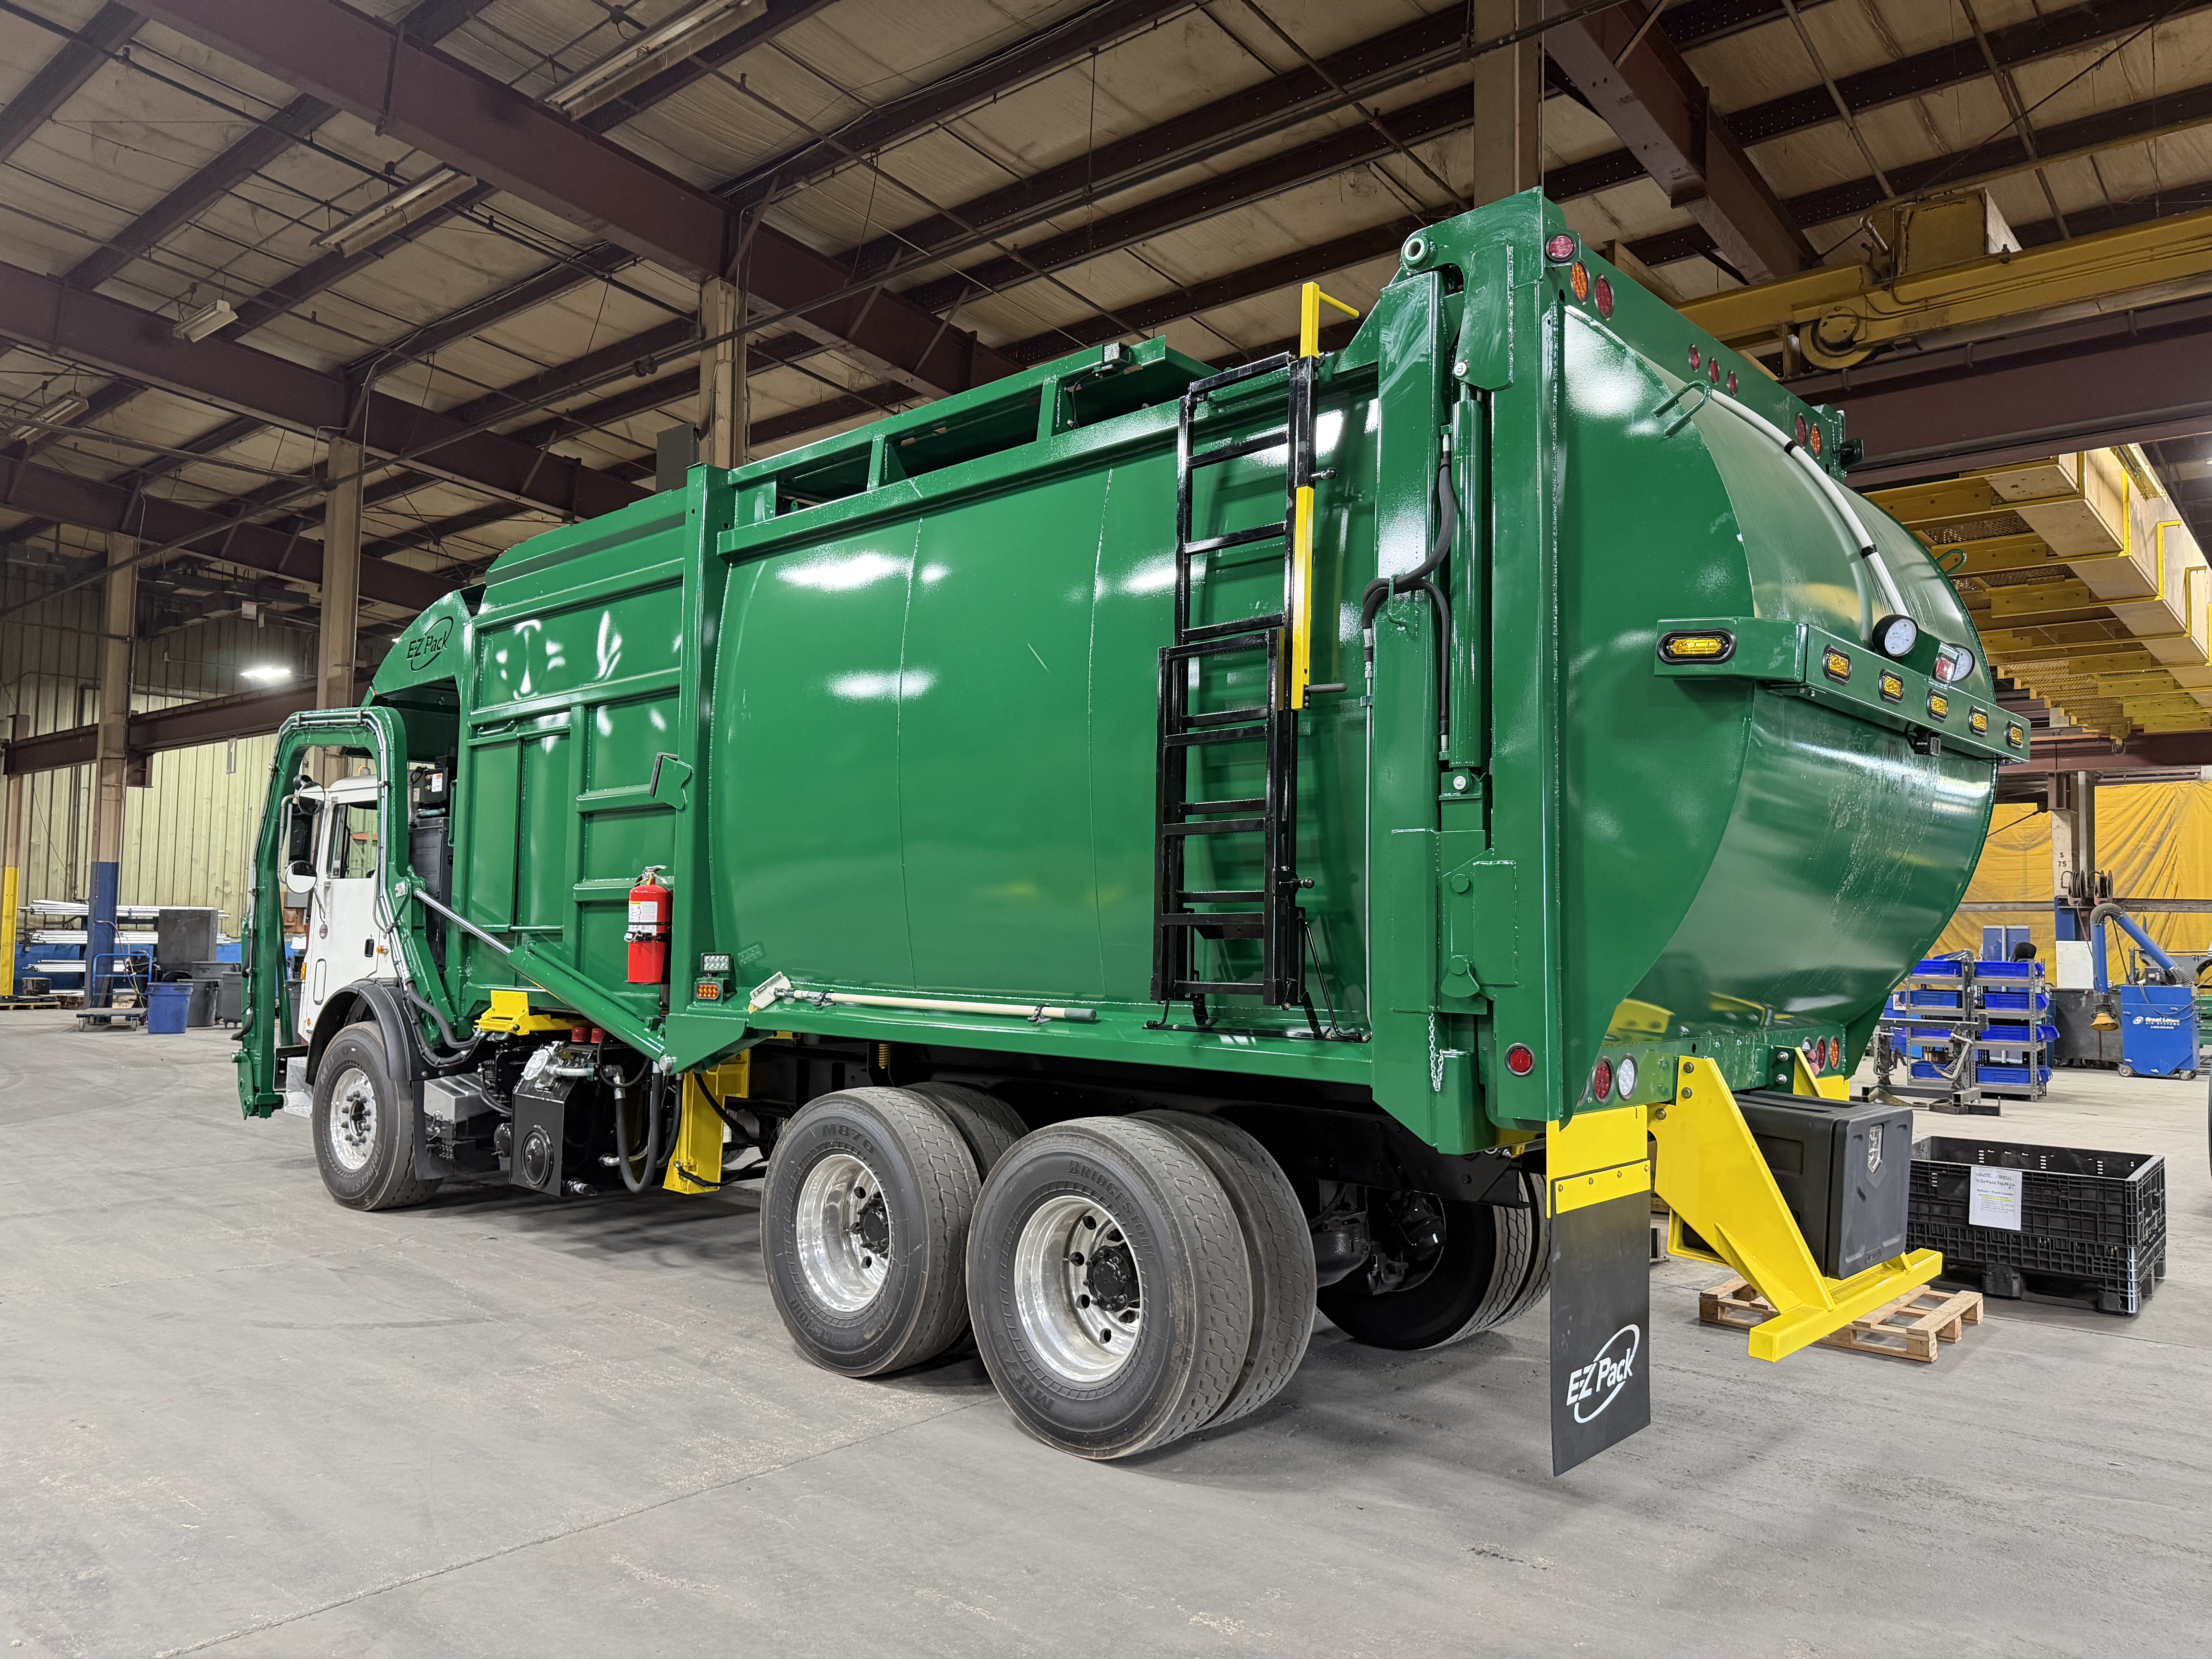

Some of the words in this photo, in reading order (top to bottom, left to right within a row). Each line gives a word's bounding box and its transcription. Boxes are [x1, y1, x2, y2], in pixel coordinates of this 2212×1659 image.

[424, 631, 447, 655] Pack
[823, 1123, 875, 1154] M870
[1067, 1159, 1158, 1264] BRIDGESTONE
[1595, 1348, 1633, 1392] Pack
